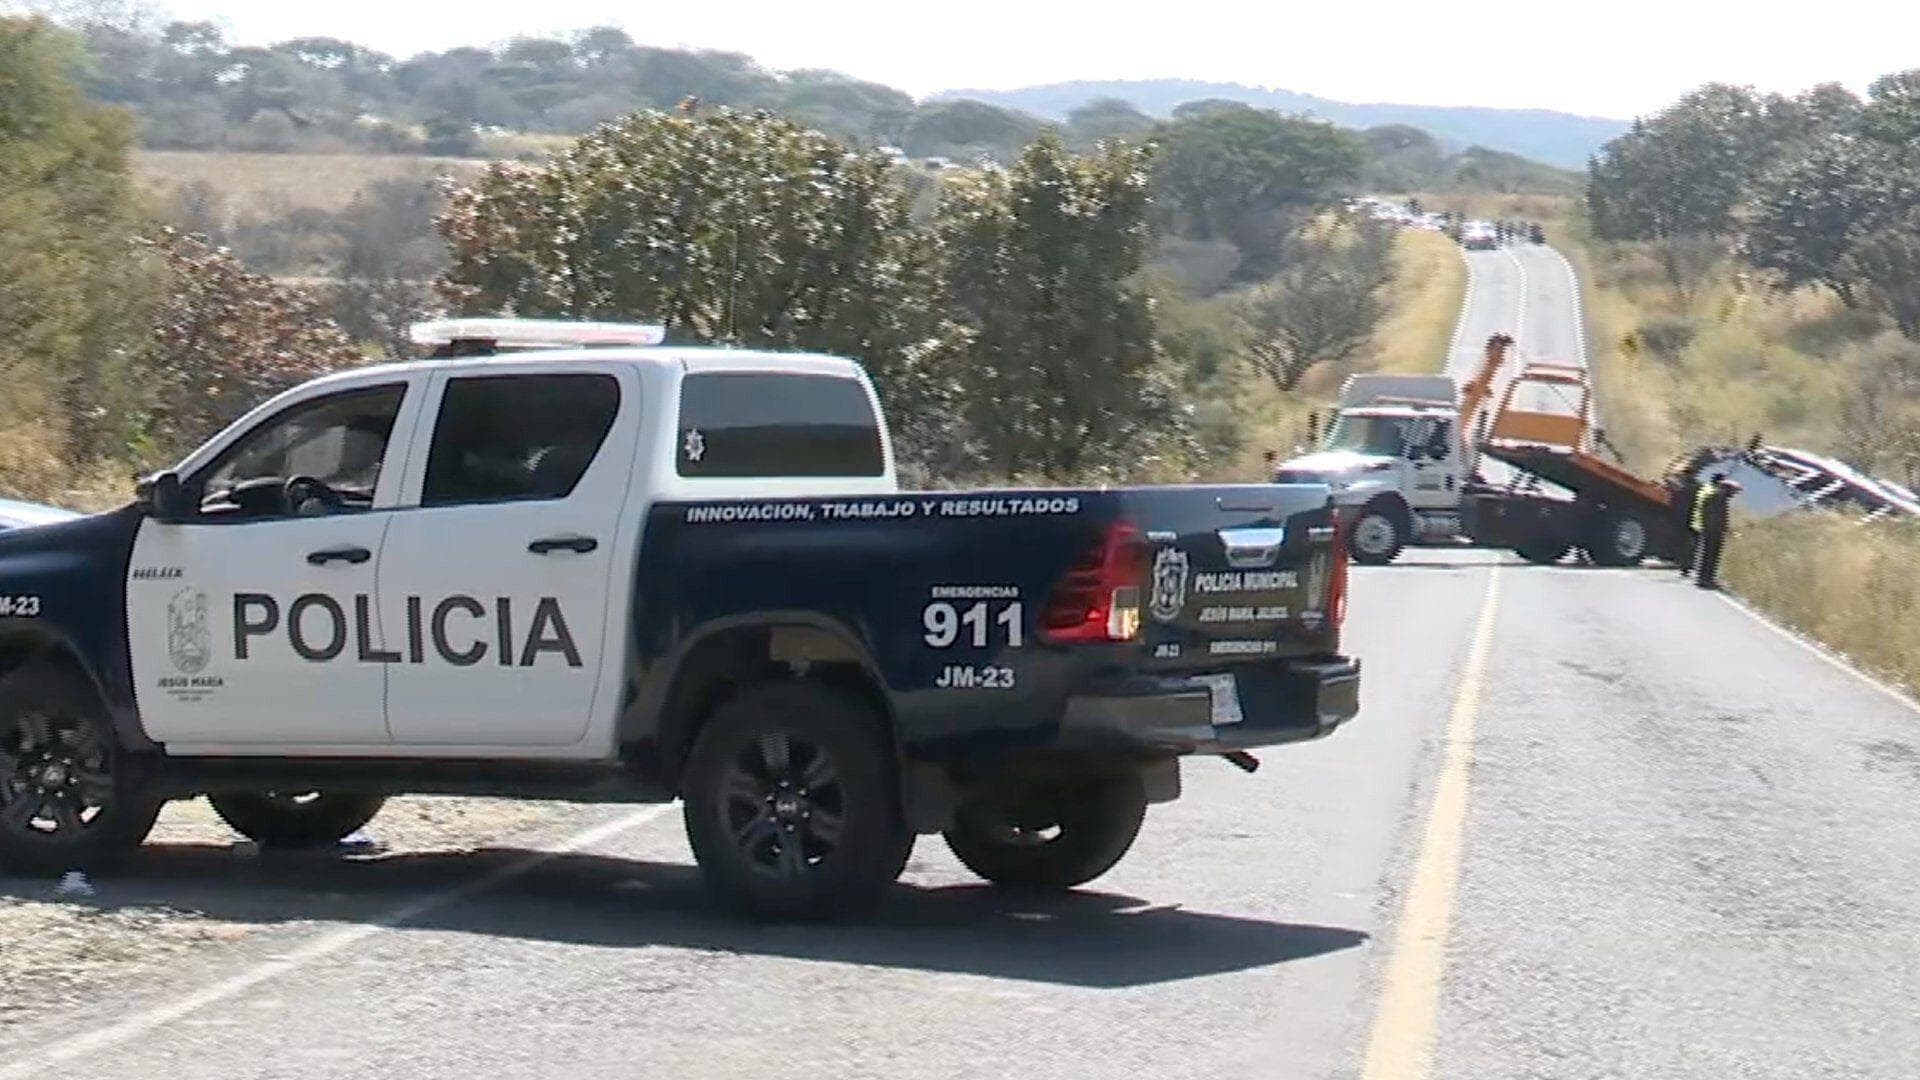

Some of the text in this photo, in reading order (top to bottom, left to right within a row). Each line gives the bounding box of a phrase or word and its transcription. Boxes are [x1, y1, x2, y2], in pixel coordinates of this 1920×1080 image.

[823, 501, 915, 518] TRABAJO
[921, 501, 936, 516] Y
[942, 498, 1079, 516] RESULTADOS
[932, 587, 1018, 597] EMERGENCIAS
[234, 593, 583, 667] POLICIA
[924, 603, 1022, 647] 911
[936, 666, 1015, 688] JM-23
